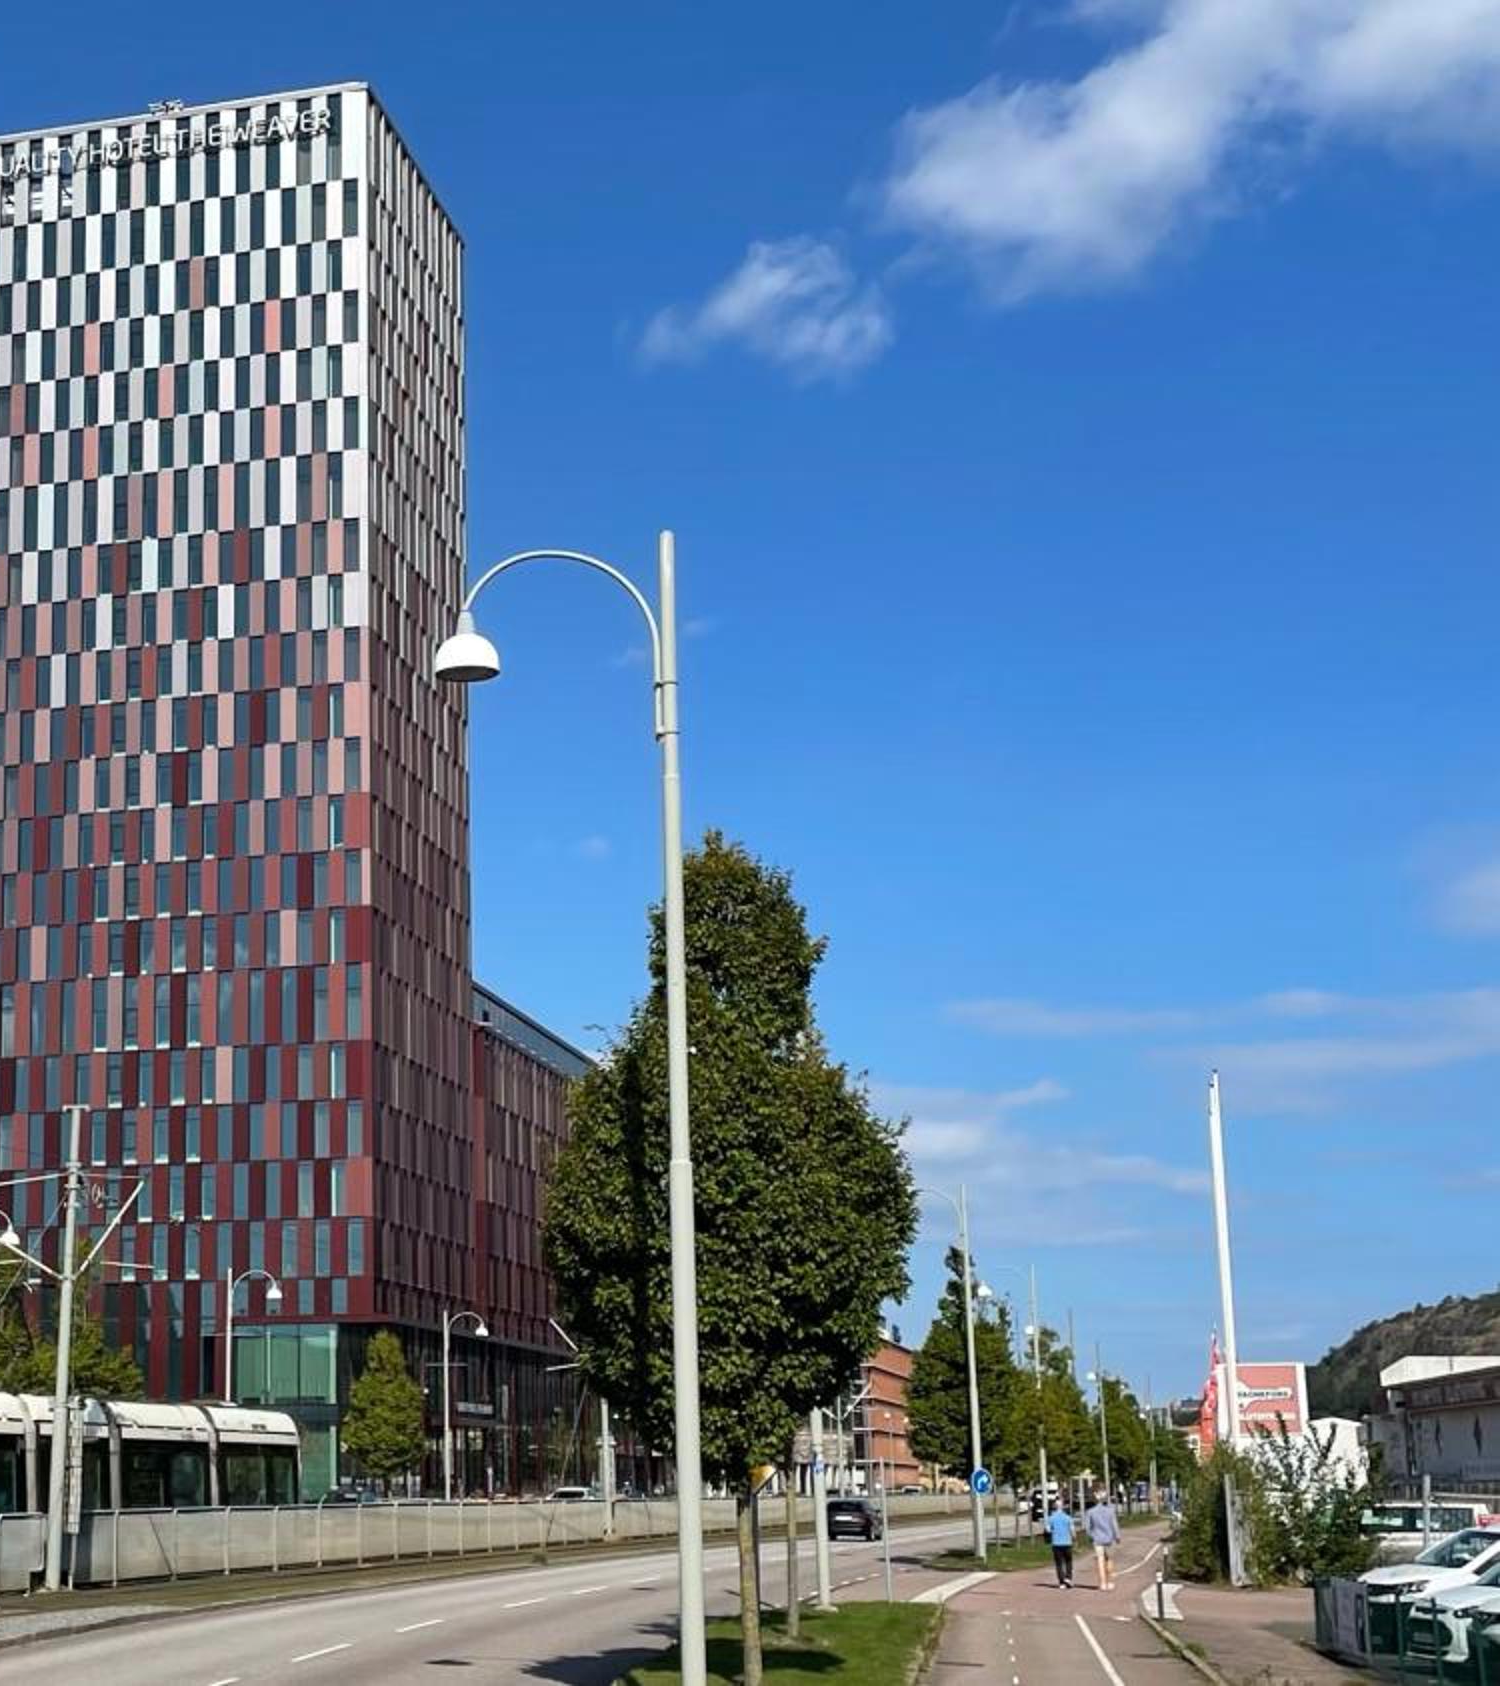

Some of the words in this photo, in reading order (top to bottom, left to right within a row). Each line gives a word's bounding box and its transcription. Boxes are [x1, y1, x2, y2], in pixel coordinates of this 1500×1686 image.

[89, 132, 169, 165] HOTEL
[175, 122, 224, 151] THE
[229, 108, 331, 145] WEAVER
